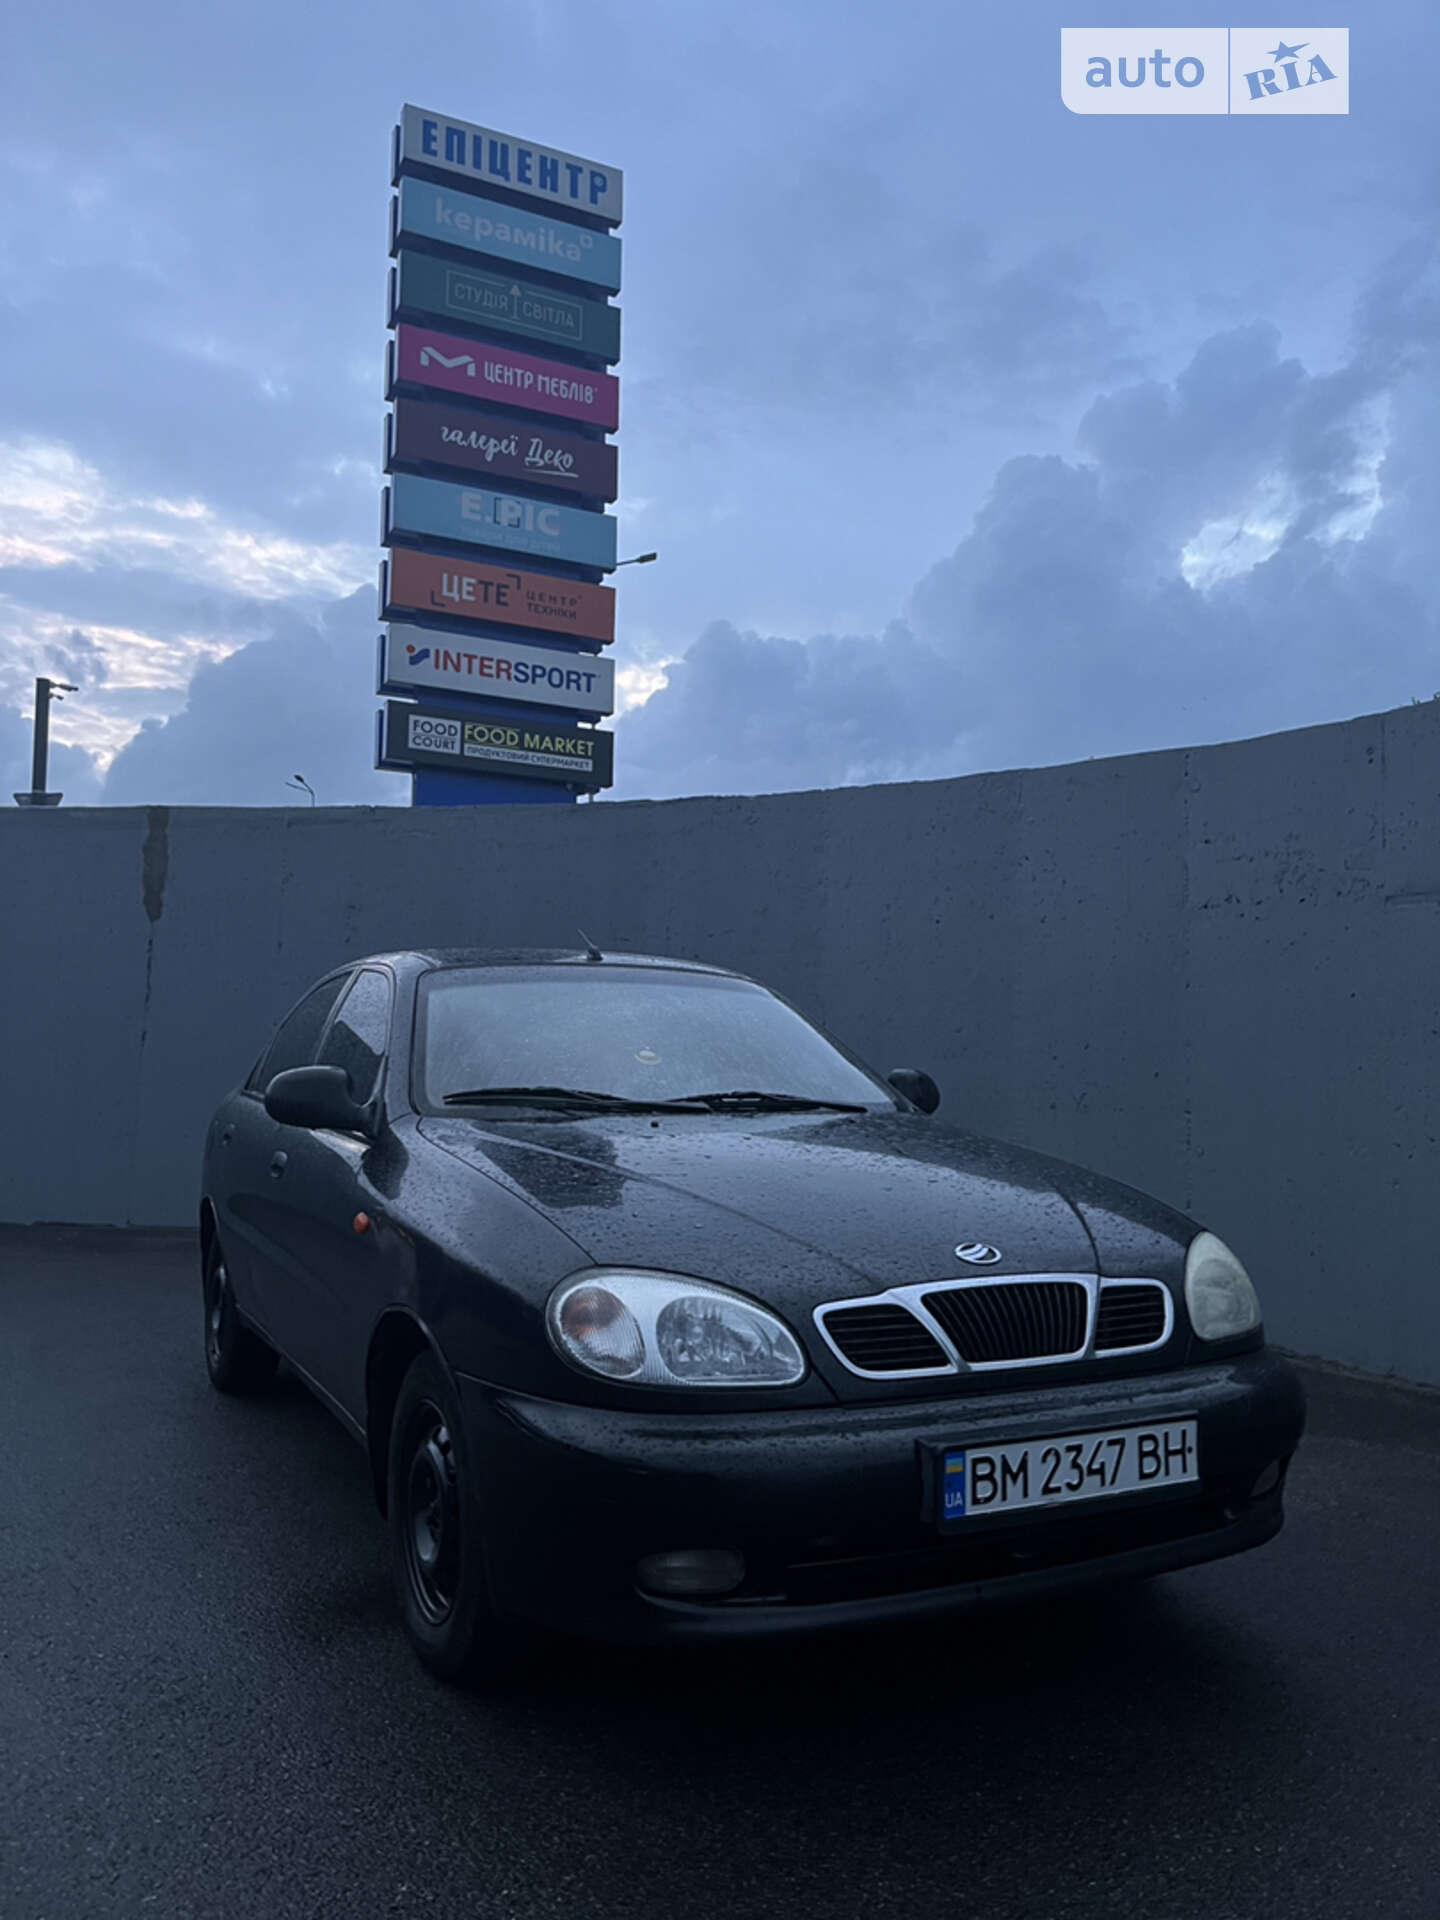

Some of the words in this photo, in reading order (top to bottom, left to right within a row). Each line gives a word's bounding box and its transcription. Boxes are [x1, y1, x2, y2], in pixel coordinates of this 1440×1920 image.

[422, 119, 608, 205] ЕПІЦЕНТР
[454, 283, 509, 312] СТУДІЯ
[522, 301, 575, 327] СВІТЛА
[484, 361, 534, 389] ЦЕНТР
[537, 374, 594, 404] МЕБЛІВ
[440, 426, 518, 462] галереї
[525, 438, 574, 472] Деко
[441, 572, 510, 608] ЦЕТЕ
[526, 591, 578, 606] ЦЕНТР
[527, 602, 577, 621] ТЕХНІКИ
[434, 649, 597, 694] INTERSPORT
[412, 718, 458, 737] FOOD
[412, 734, 457, 751] COURT
[464, 724, 519, 746] FOOD
[524, 733, 595, 757] MARKET
[970, 1450, 1029, 1505] BM
[1041, 1437, 1126, 1496] 2347
[1137, 1429, 1188, 1480] BH
[944, 1492, 964, 1509] UA
